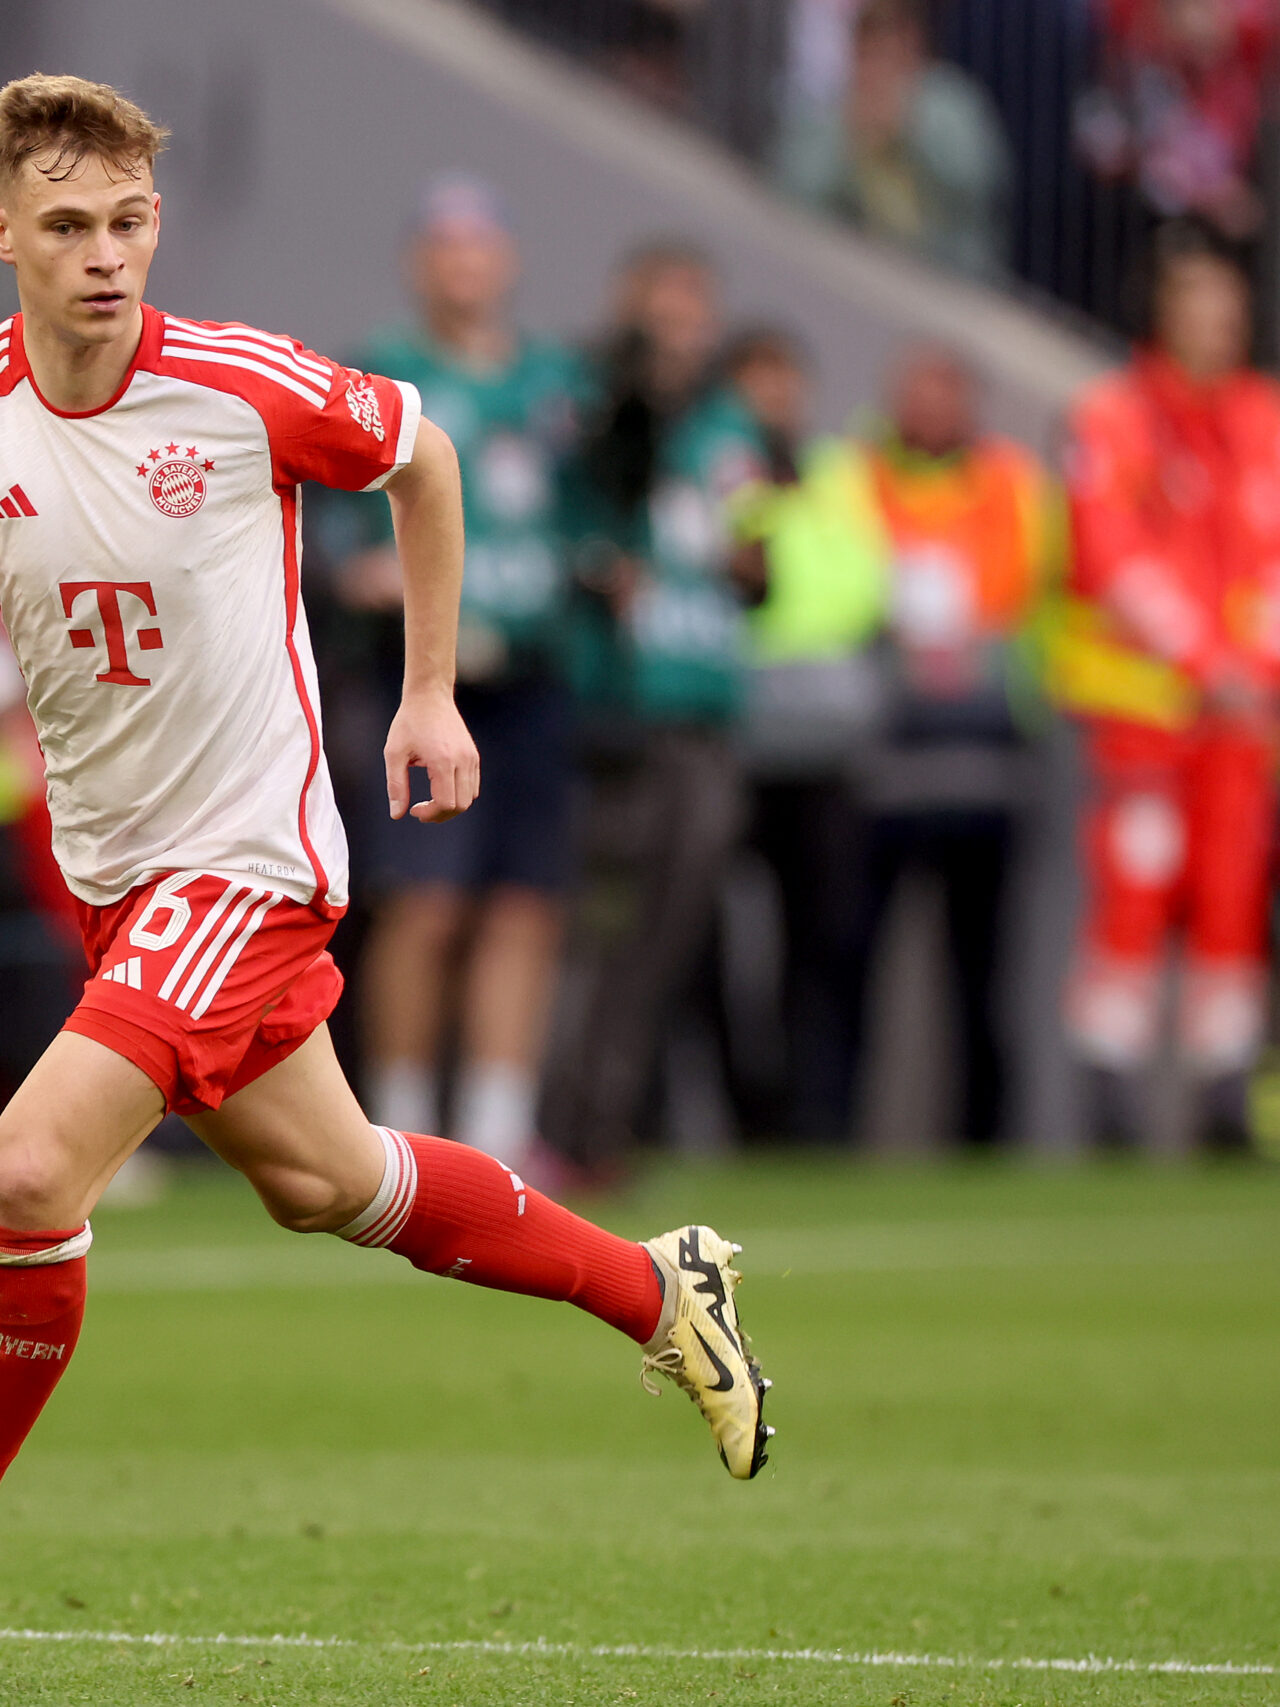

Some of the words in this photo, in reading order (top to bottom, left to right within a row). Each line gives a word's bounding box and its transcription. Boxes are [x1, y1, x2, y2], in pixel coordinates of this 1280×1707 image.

[153, 473, 165, 488] FC
[163, 464, 201, 483] BAYERN
[129, 869, 204, 952] 6
